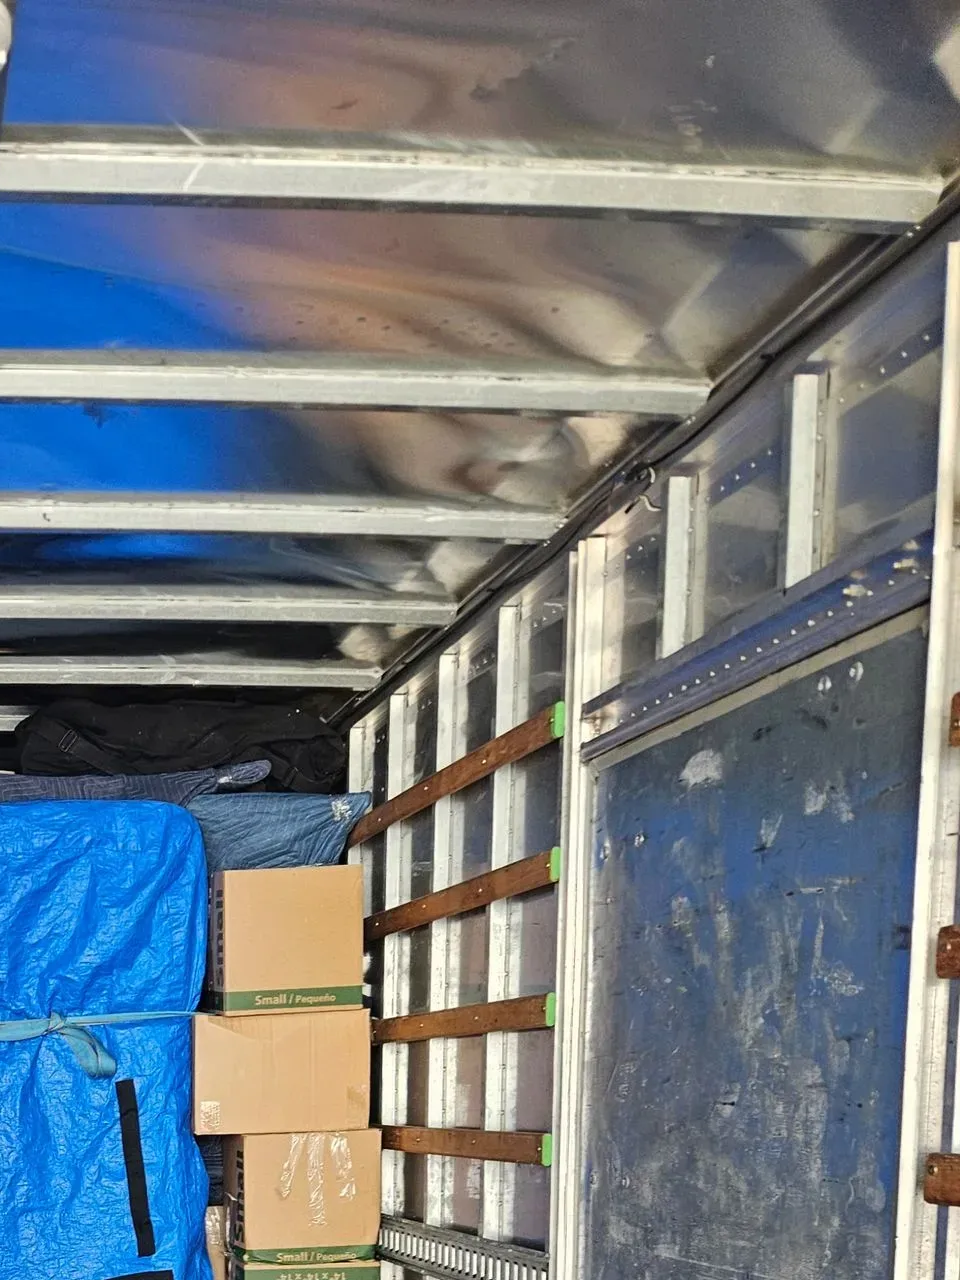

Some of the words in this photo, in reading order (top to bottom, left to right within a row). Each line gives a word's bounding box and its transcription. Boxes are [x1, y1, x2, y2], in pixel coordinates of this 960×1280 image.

[254, 993, 287, 1006] Small
[288, 993, 295, 1005] /
[276, 1251, 308, 1263] Small
[321, 1272, 329, 1280] x
